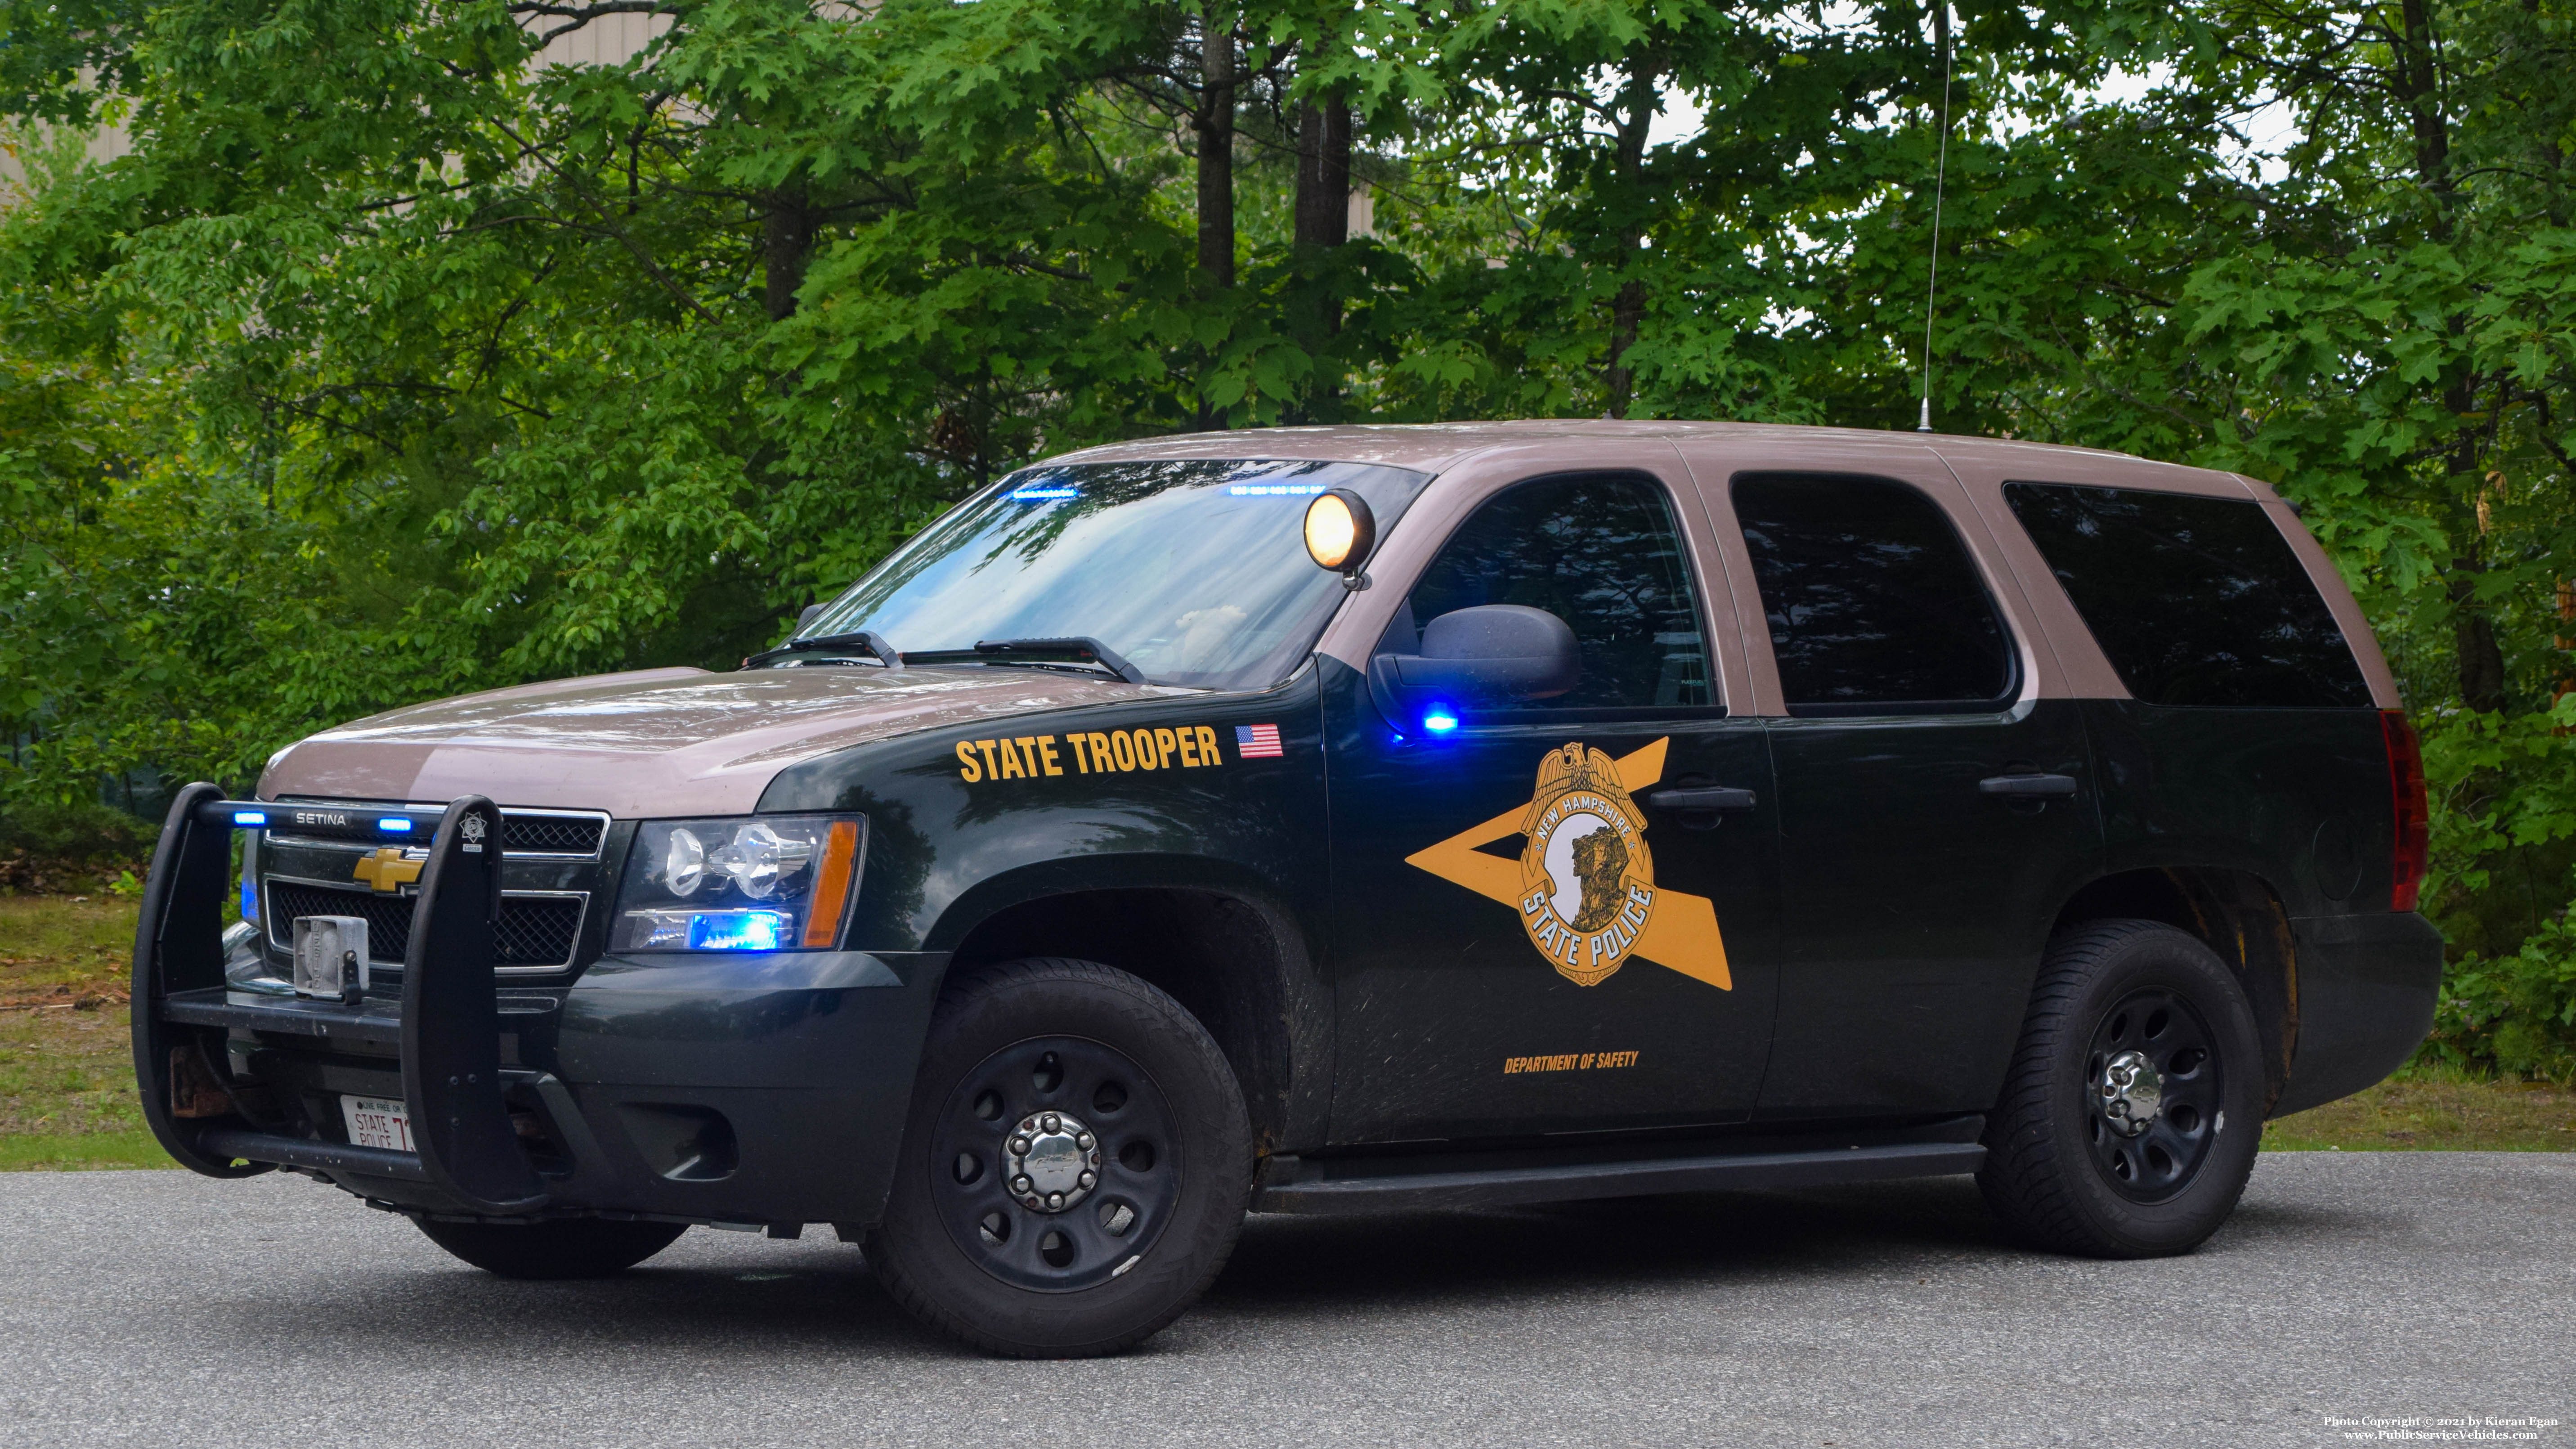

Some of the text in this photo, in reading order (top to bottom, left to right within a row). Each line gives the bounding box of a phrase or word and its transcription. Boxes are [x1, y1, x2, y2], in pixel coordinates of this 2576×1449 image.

[956, 726, 1222, 783] STATE TROOPER
[296, 812, 346, 825] SETINA
[1537, 795, 1632, 840] NEW HAMPSHIRE
[1523, 884, 1653, 966] STATE POLICE
[1504, 1051, 1639, 1074] DEPARTMENT OF SAFETY
[363, 1102, 375, 1110] LIVE
[376, 1103, 390, 1112] FREE
[392, 1105, 401, 1113] OR
[355, 1113, 389, 1133] STATE
